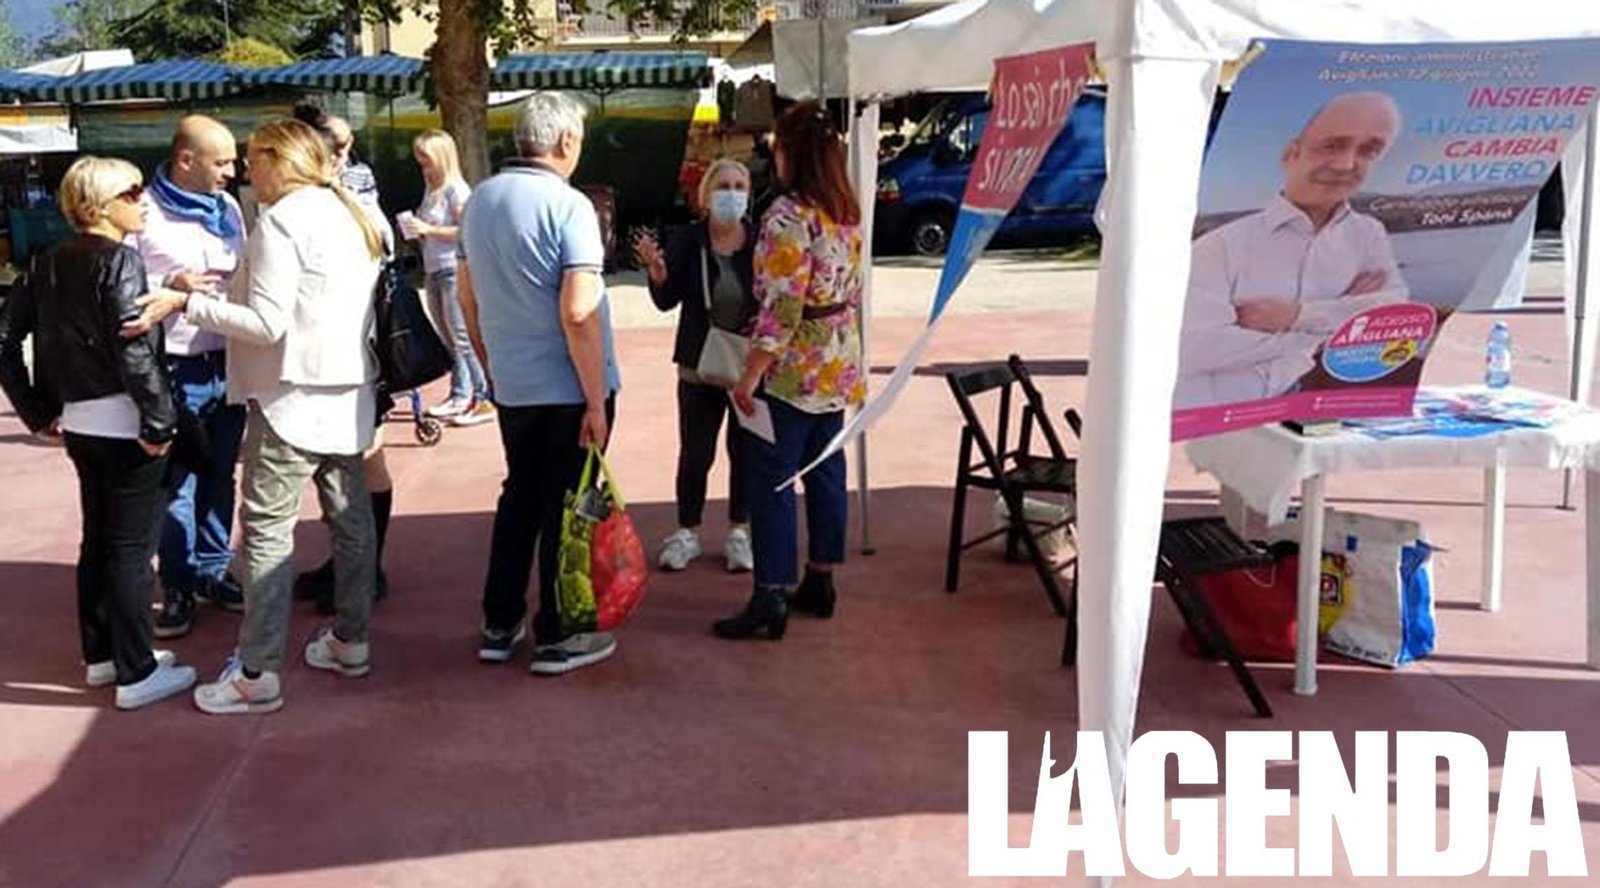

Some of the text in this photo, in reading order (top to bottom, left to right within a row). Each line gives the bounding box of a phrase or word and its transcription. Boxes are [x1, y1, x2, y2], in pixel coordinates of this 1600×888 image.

[1468, 85, 1597, 109] INSIEME
[1413, 112, 1577, 135] AVIGLIANA
[1444, 137, 1559, 159] CAMBIA
[1405, 160, 1547, 185] DAVVERO
